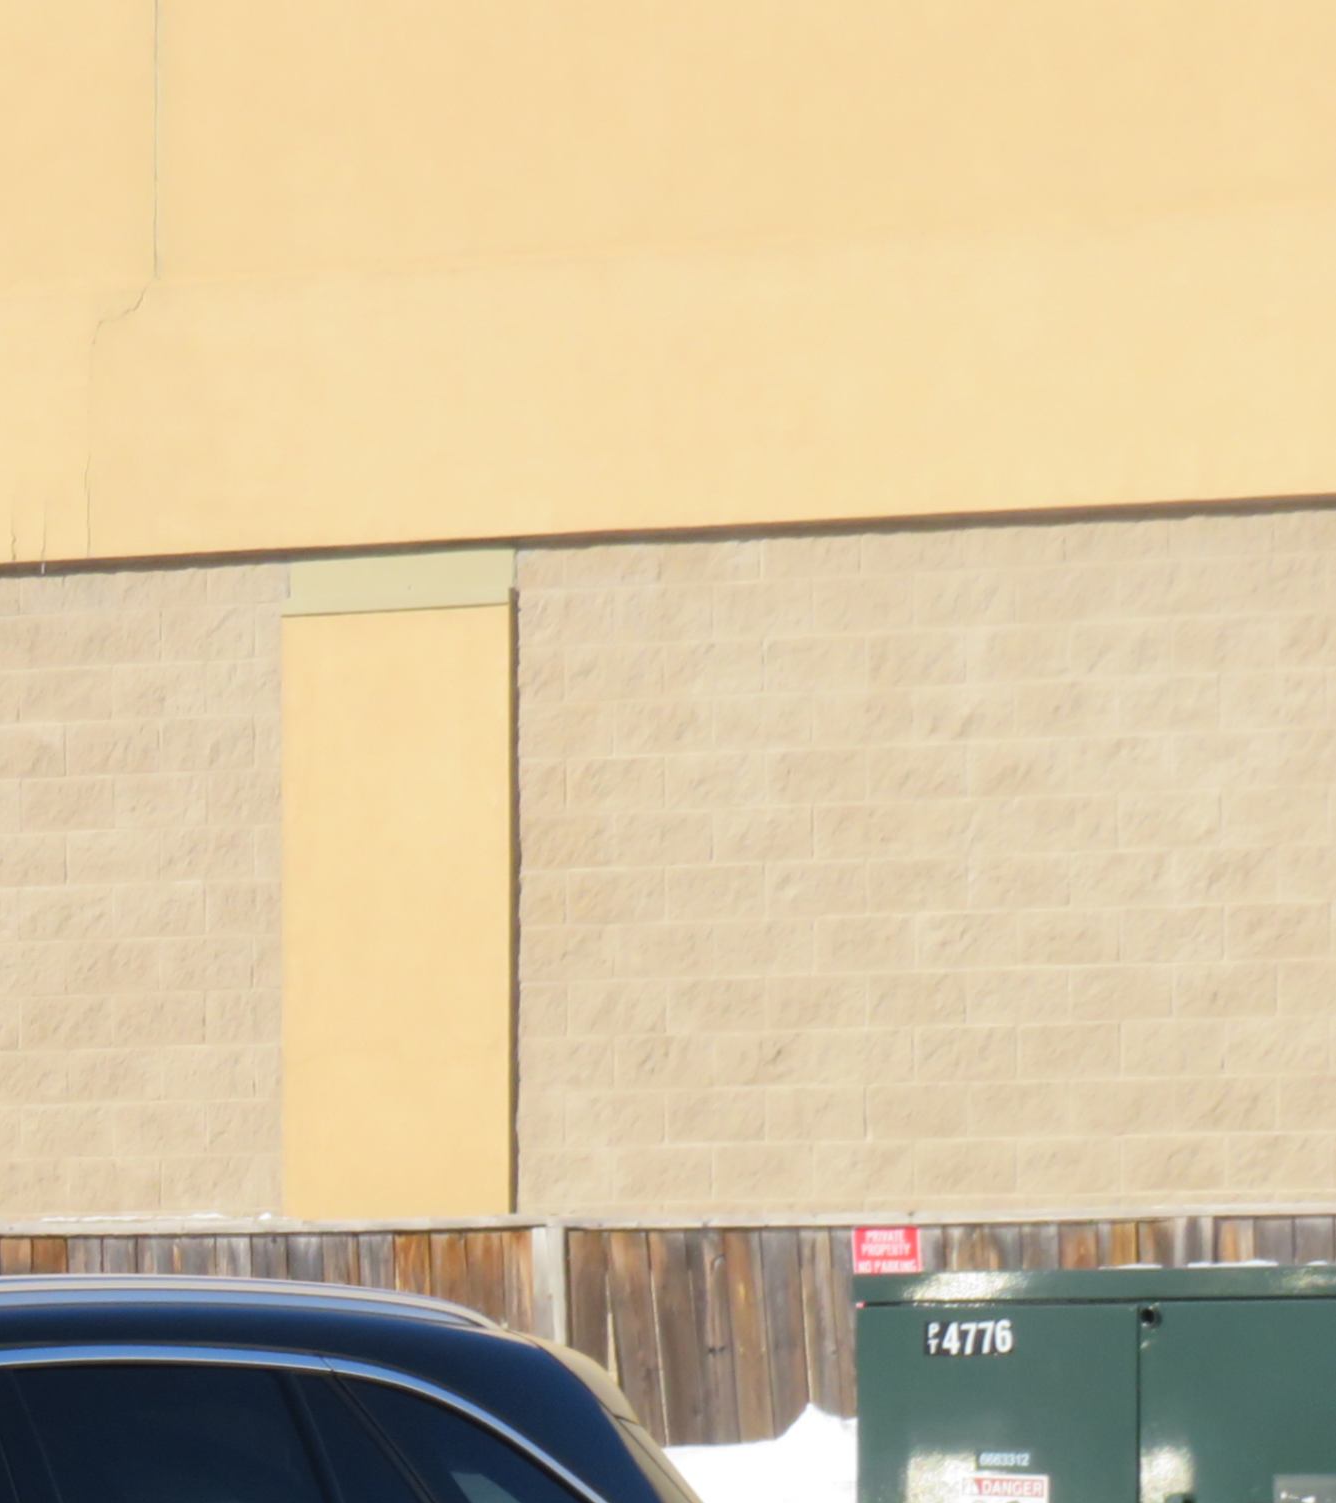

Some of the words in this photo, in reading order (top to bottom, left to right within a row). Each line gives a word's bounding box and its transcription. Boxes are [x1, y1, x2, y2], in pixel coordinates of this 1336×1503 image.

[860, 1244, 911, 1256] PROPERTY
[858, 1260, 872, 1273] NO
[942, 1319, 1013, 1355] 4776
[982, 1480, 1043, 1496] DANGER
